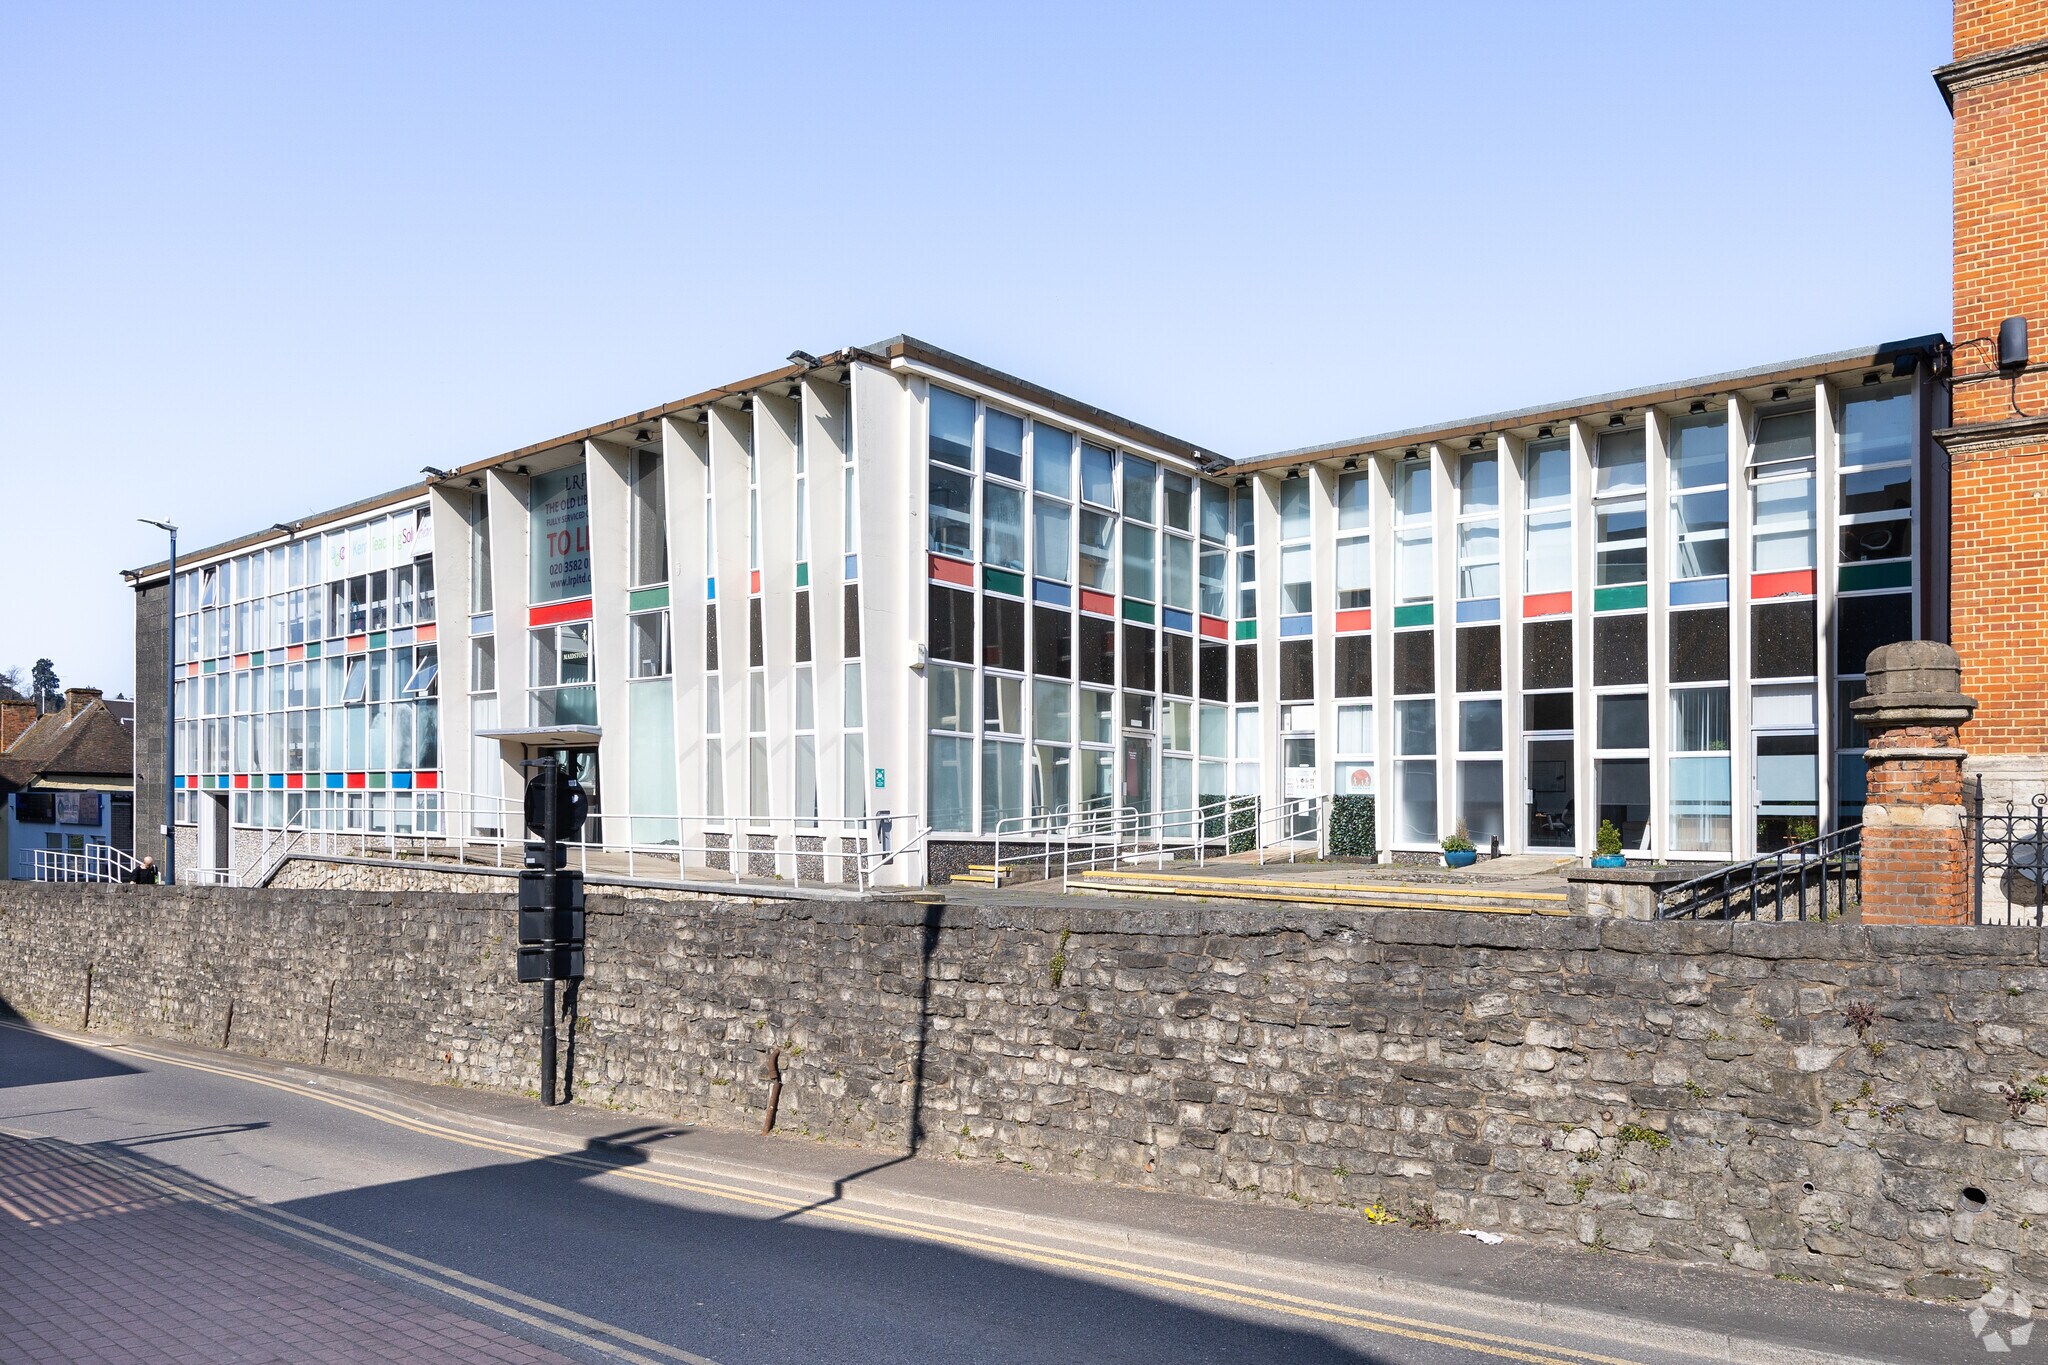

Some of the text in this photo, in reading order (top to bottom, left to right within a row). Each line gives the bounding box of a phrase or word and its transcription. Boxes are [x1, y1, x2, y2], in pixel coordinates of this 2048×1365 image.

[545, 501, 560, 514] THE
[560, 497, 576, 510] OLD
[546, 529, 571, 558] TO
[549, 562, 563, 576] 020
[564, 559, 583, 573] 3582
